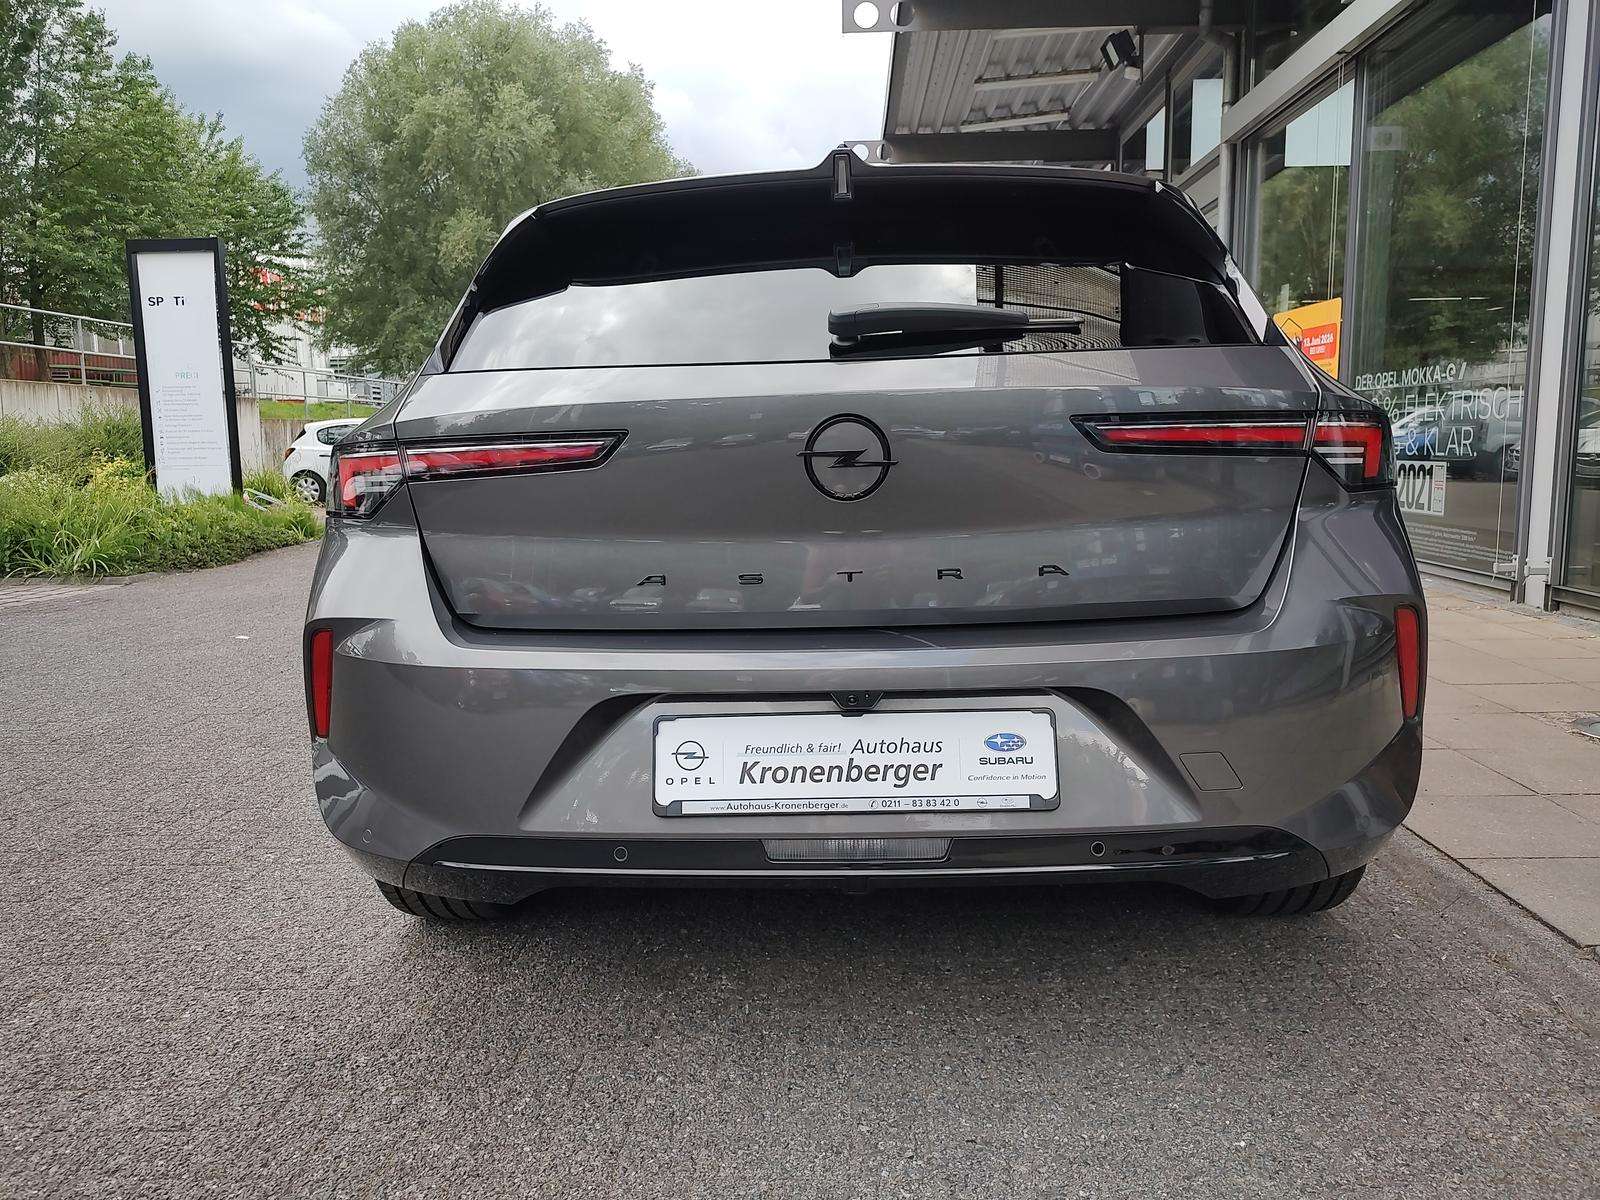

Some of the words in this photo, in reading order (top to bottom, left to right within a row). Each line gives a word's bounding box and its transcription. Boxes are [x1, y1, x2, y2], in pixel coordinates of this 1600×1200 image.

[1355, 373, 1373, 390] DER
[1374, 370, 1399, 388] OPEL
[1404, 385, 1523, 422] ELEKTRISCH
[1405, 428, 1419, 456] &
[1424, 426, 1478, 457] KLAR.
[1398, 463, 1434, 512] 2021
[636, 564, 1070, 586] ASTRA
[744, 743, 802, 755] Freundlich
[806, 743, 814, 753] &
[817, 742, 842, 753] fair!
[850, 737, 943, 754] Autohaus
[979, 756, 1034, 765] SUBARU
[665, 776, 715, 786] OPEL
[739, 758, 943, 788] Kronenberger
[967, 774, 1011, 782] Confidence
[709, 801, 849, 811] www.Autohaus-Kronenberger.de
[881, 799, 901, 808] 0211
[911, 799, 923, 808] 83
[926, 799, 937, 807] 83
[940, 799, 951, 807] 42
[953, 798, 960, 807] 0
